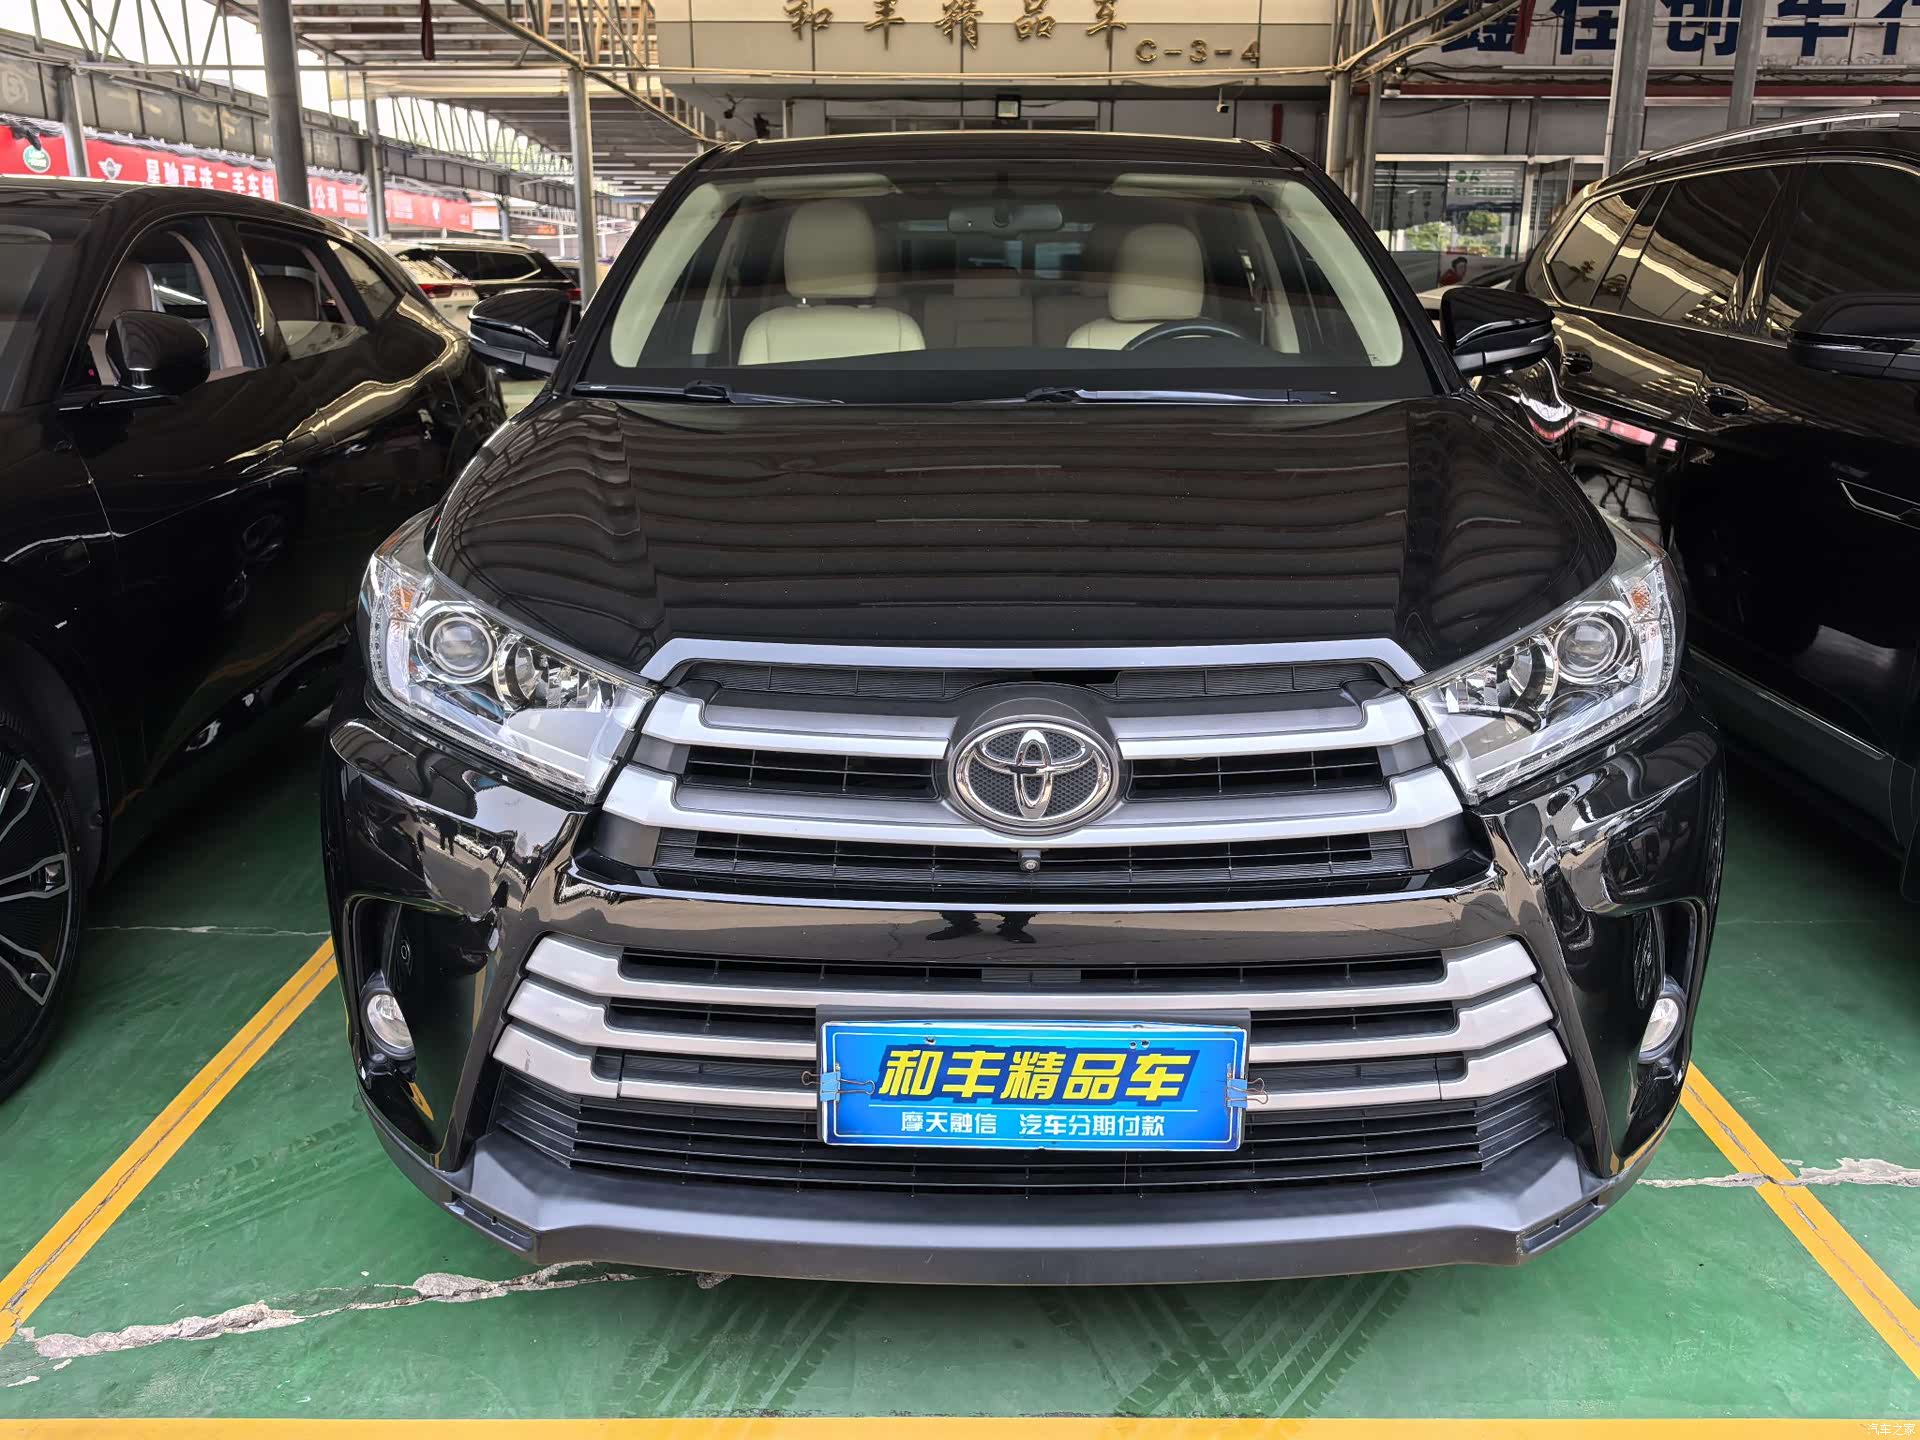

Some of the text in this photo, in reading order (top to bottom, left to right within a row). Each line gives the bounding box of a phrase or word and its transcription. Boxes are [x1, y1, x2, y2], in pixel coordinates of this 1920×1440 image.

[1135, 39, 1259, 63] C-3-4
[878, 1049, 1191, 1101] 和丰精品车
[901, 1111, 1166, 1136] 摩天融信 汽车分期付款
